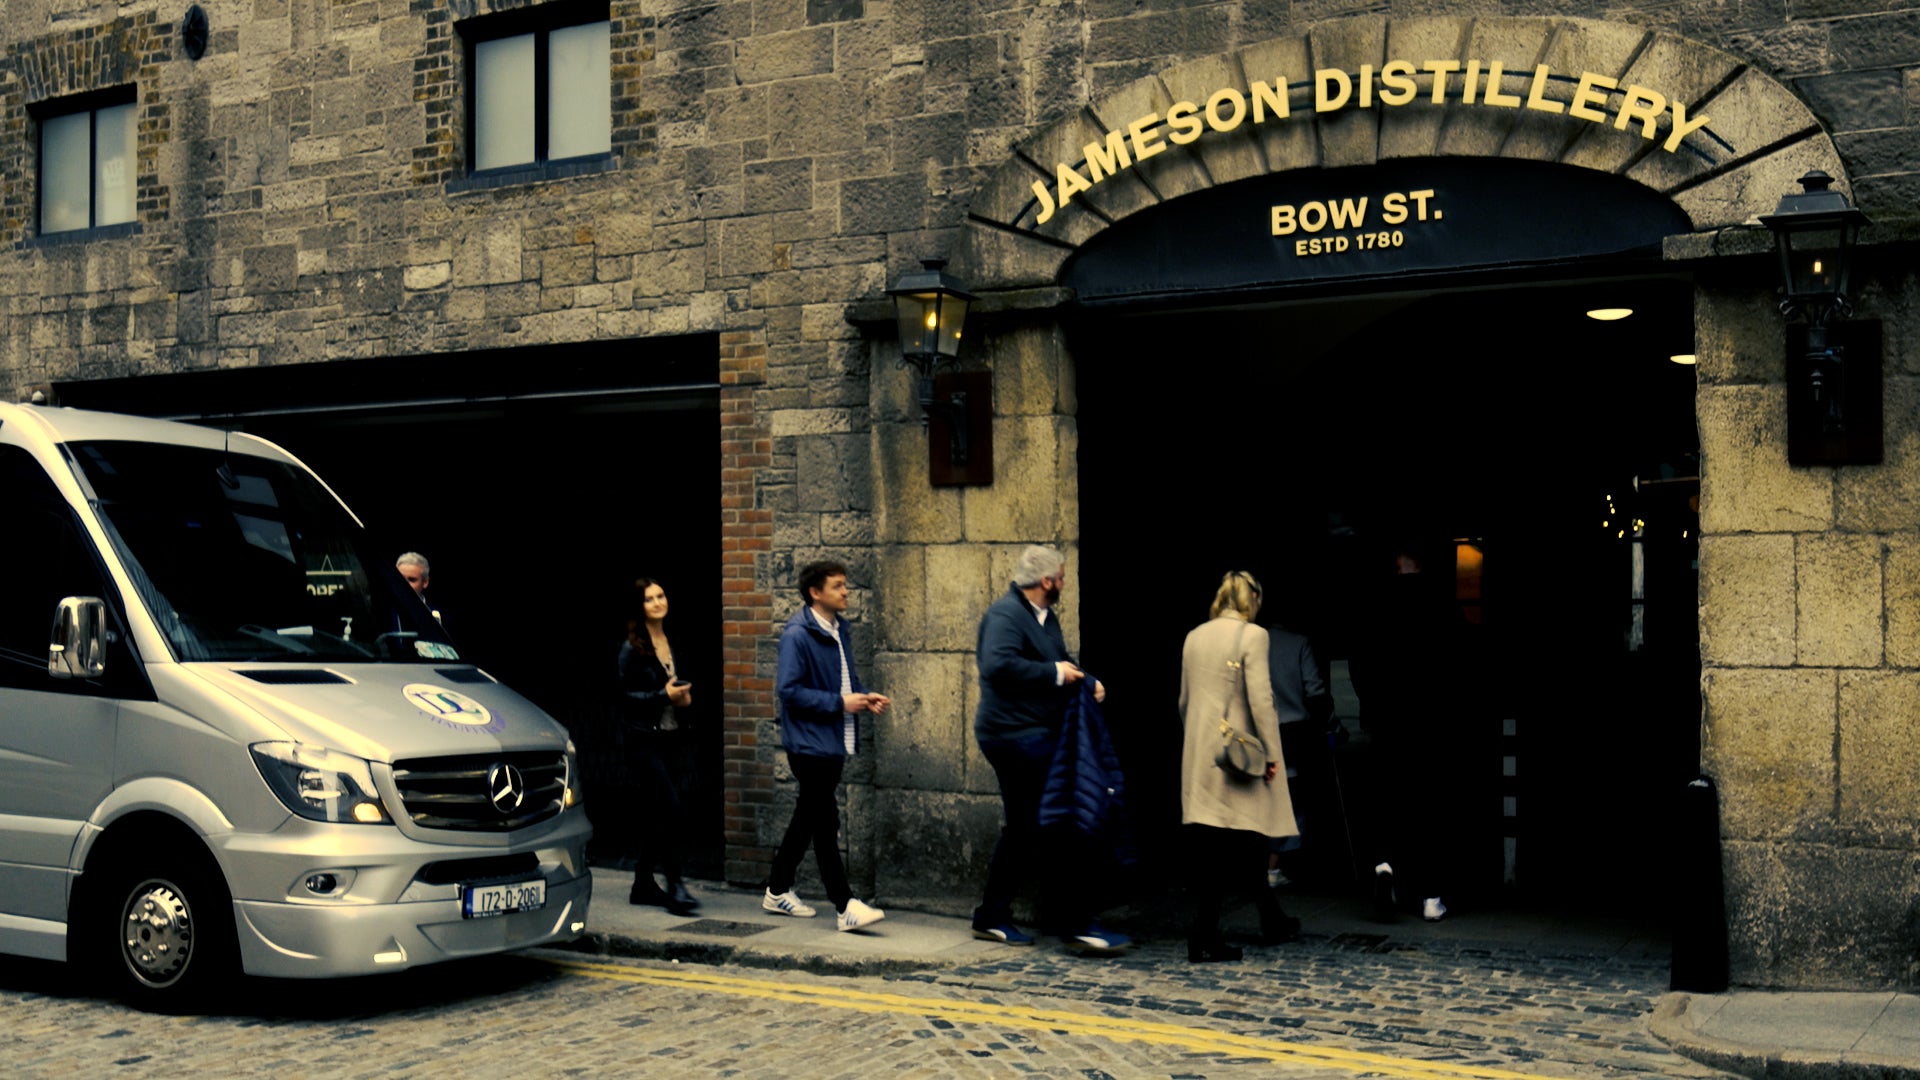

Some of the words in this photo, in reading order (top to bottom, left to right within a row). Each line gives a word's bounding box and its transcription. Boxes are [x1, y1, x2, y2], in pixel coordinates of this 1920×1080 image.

[1031, 77, 1290, 225] JAMESON
[1314, 60, 1711, 154] DISTILLERY
[1271, 196, 1368, 236] BOW
[1382, 189, 1443, 225] ST.
[1295, 236, 1349, 256] ESTD
[1356, 230, 1404, 250] 1780
